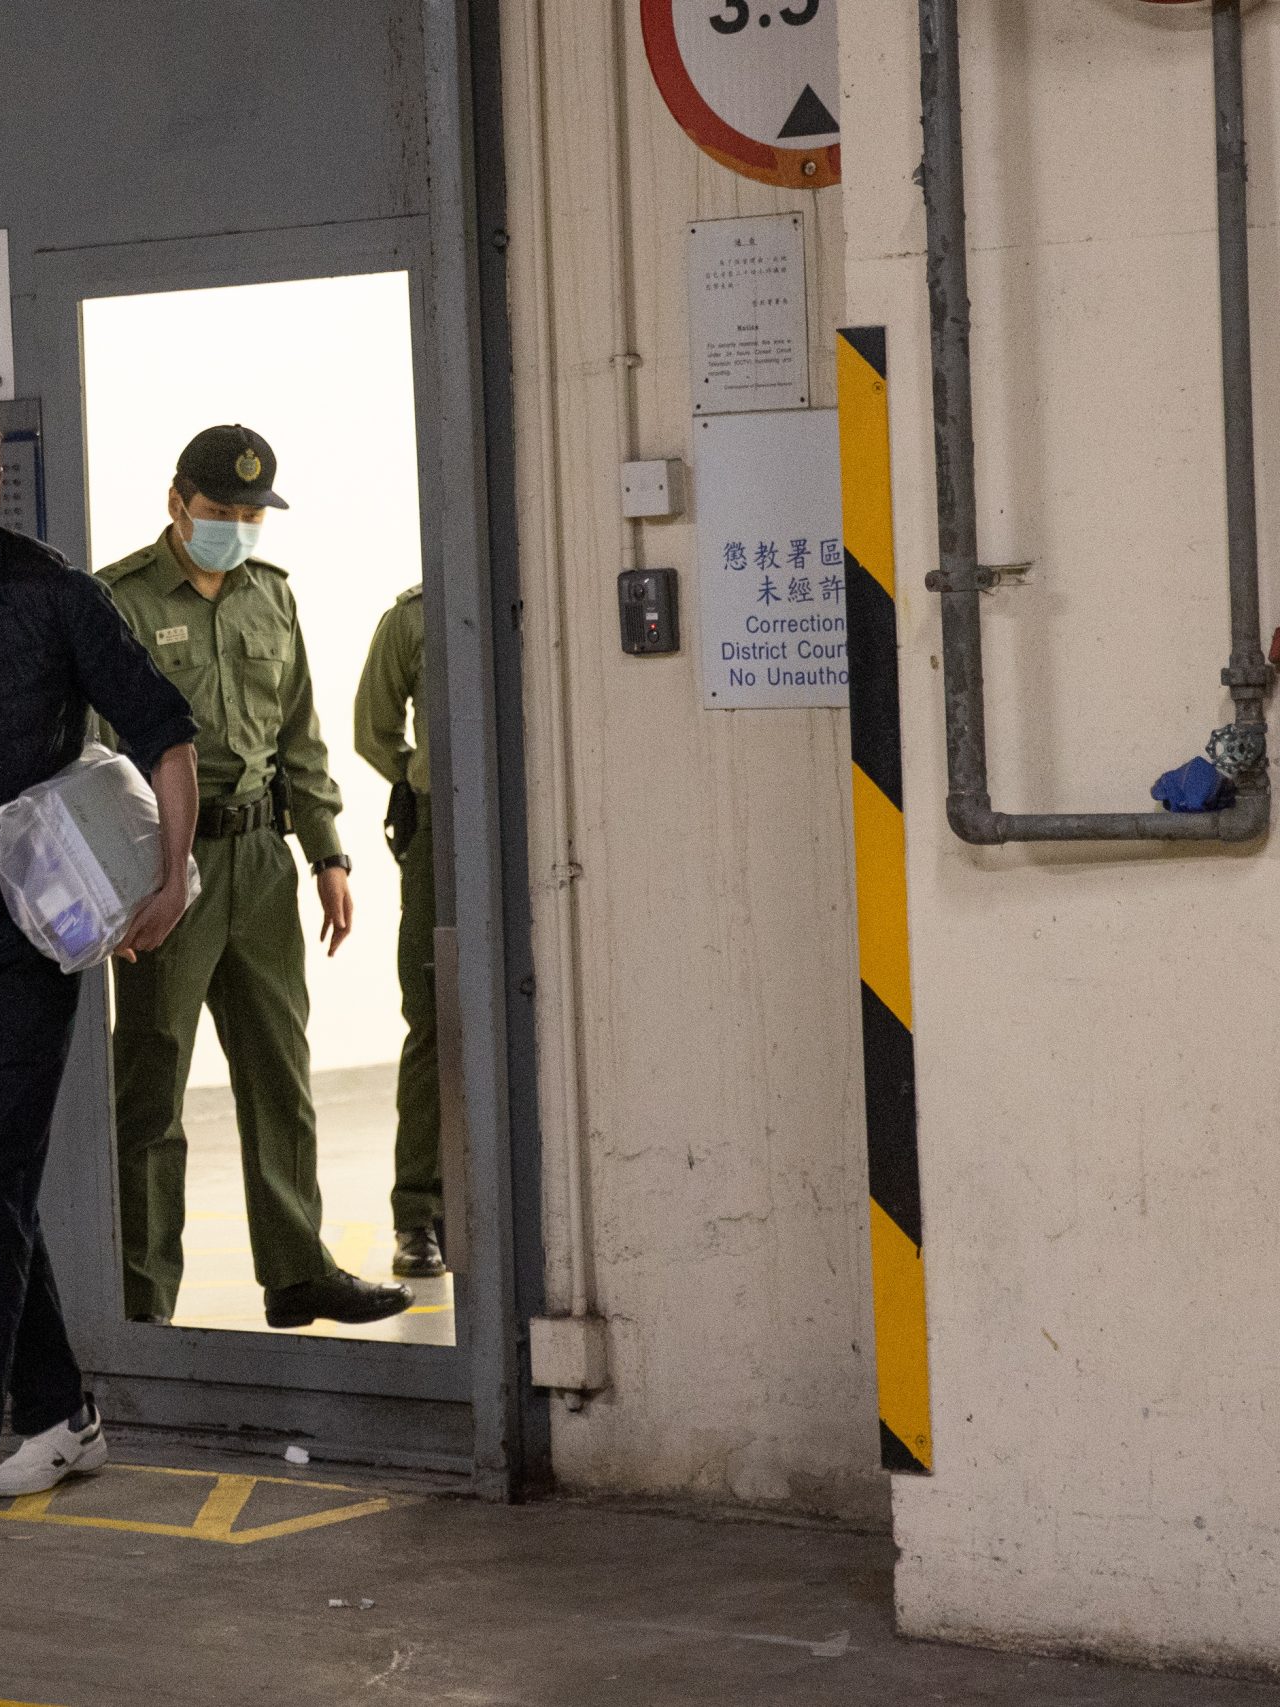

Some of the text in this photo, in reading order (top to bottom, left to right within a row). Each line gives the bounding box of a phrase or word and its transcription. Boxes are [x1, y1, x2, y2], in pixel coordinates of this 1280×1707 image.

[723, 538, 843, 571] 懲教署區
[757, 574, 846, 606] 未經許
[722, 641, 787, 660] District
[730, 668, 756, 686] No
